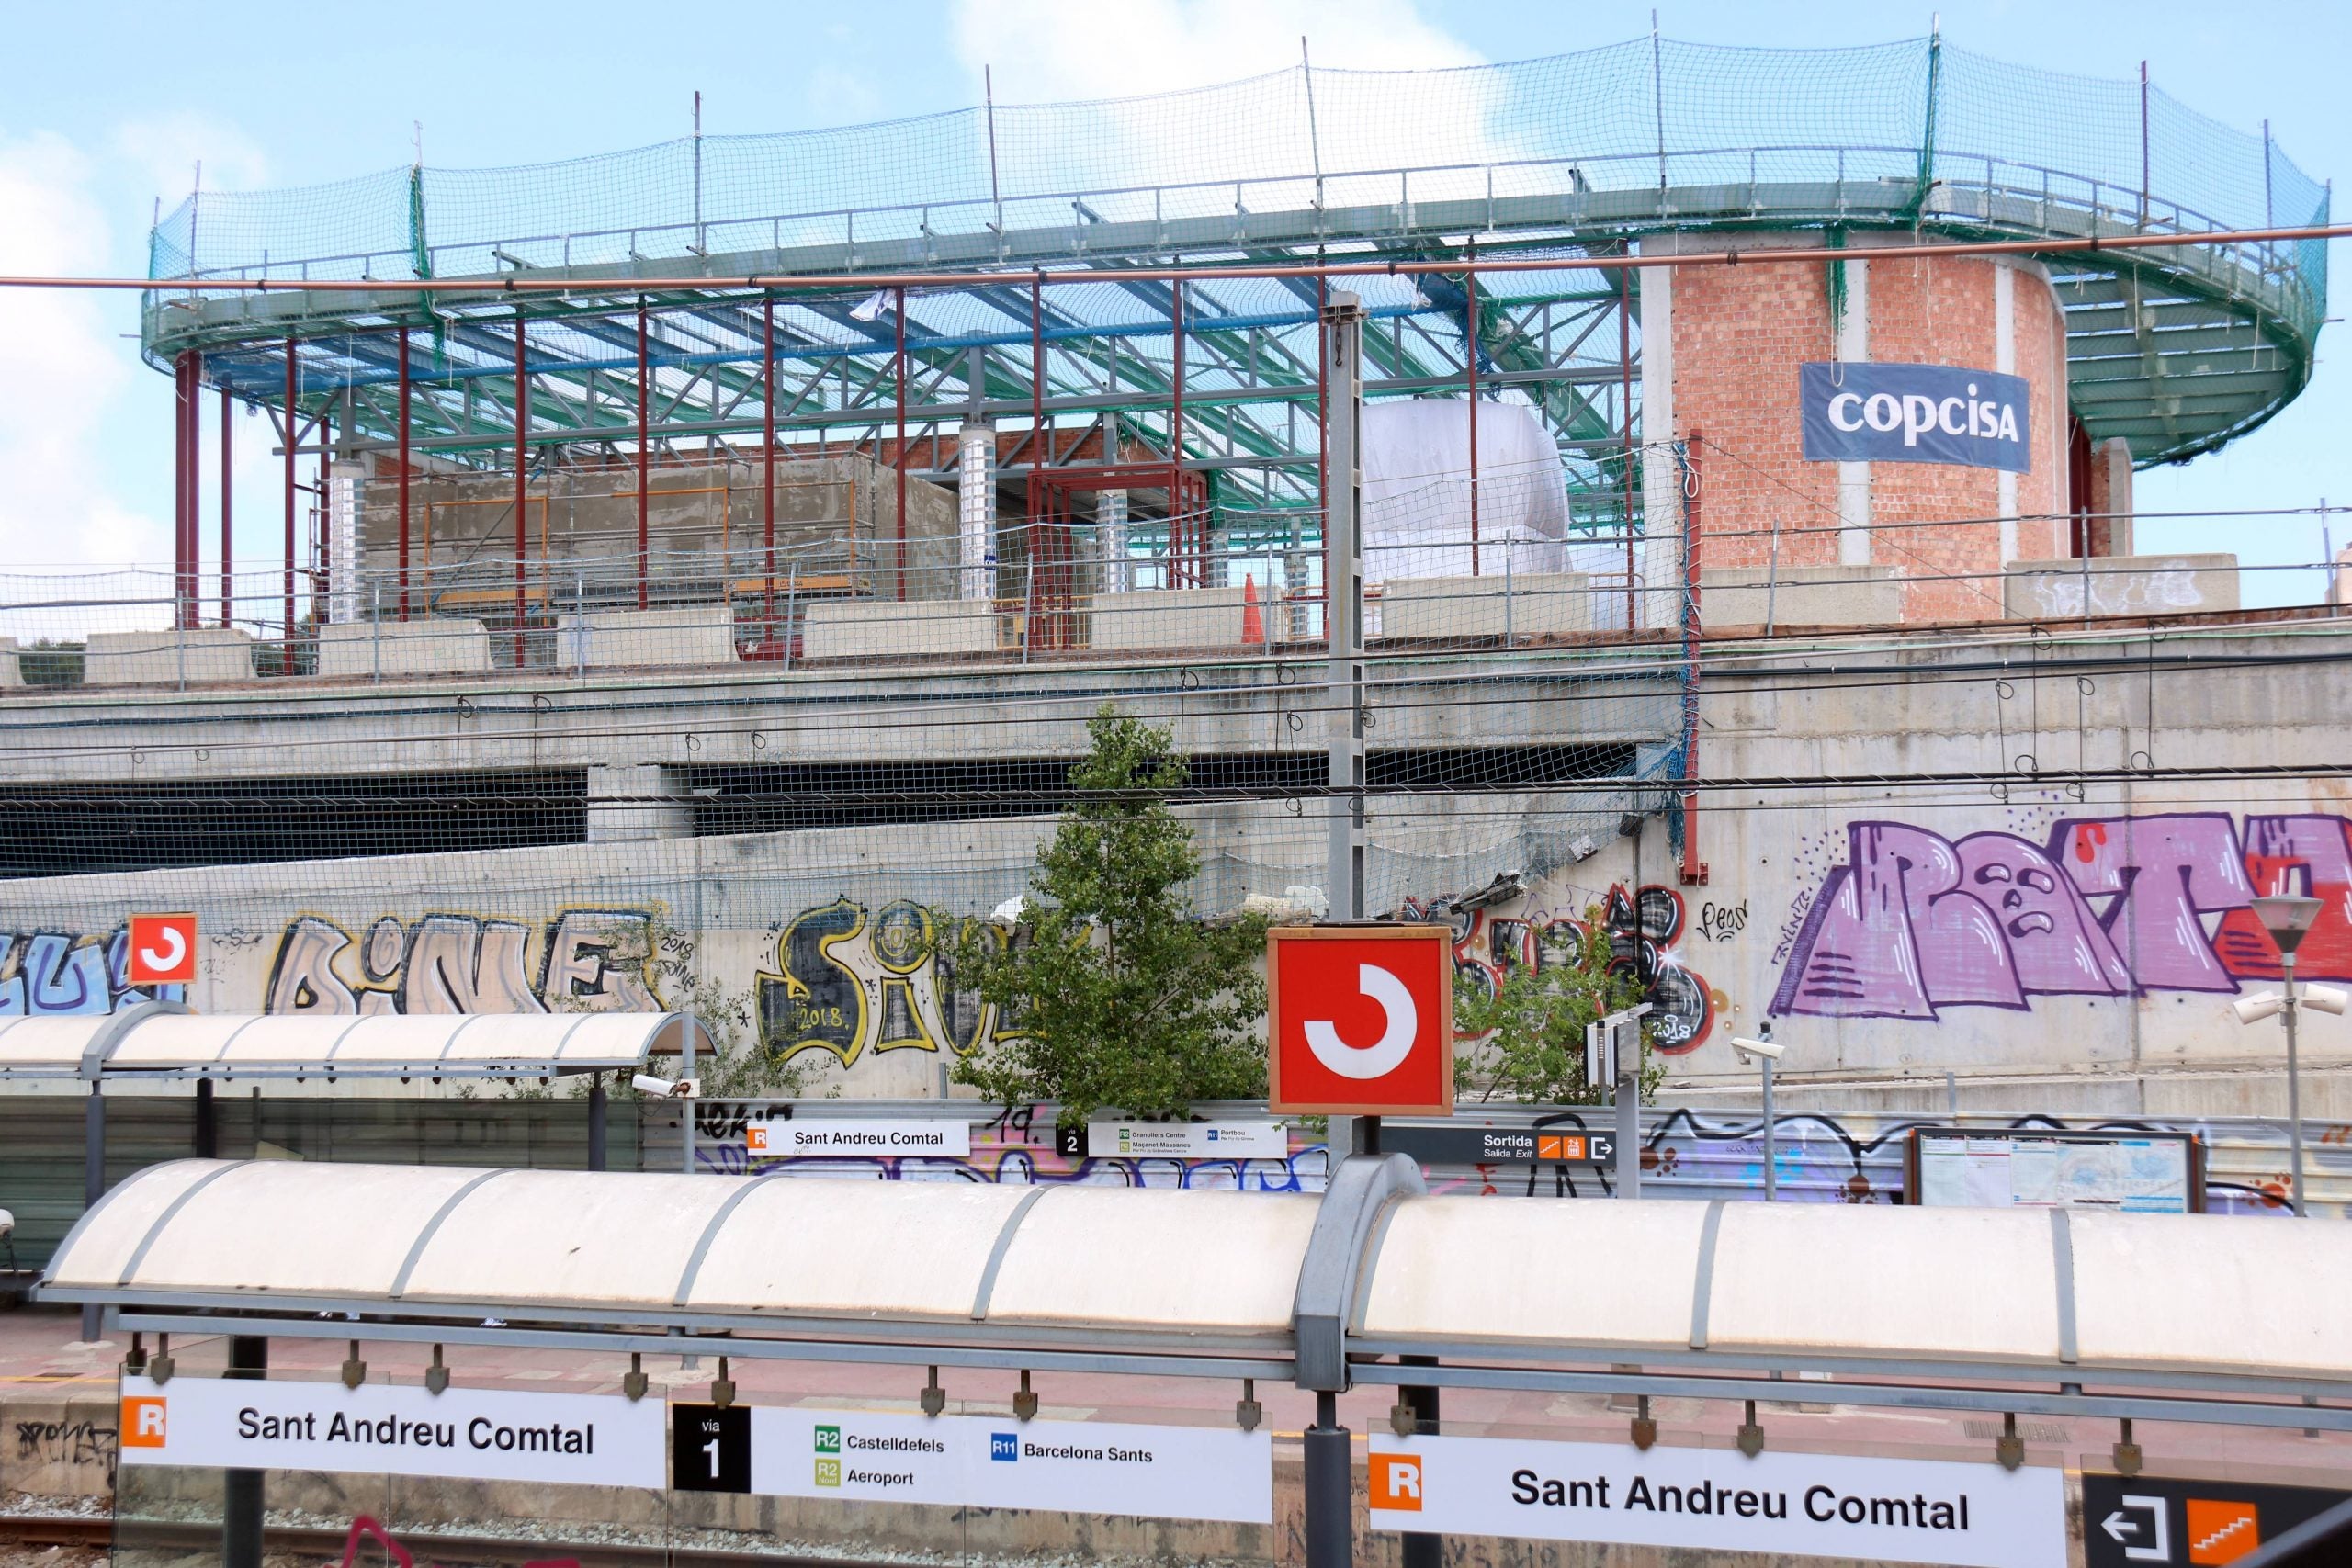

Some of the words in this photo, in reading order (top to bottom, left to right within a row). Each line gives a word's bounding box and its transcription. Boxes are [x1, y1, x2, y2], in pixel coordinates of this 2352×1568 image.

[661, 937, 695, 961] 2018
[753, 1132, 765, 1145] R
[796, 1133, 827, 1145] Sant
[833, 1133, 886, 1145] Andreu
[891, 1132, 943, 1145] Comtal
[1067, 1136, 1078, 1152] 2
[1484, 1134, 1532, 1147] Sortida
[1484, 1148, 1511, 1158] Salida
[1515, 1149, 1532, 1158] Exit
[139, 1404, 165, 1435] R
[238, 1407, 316, 1440] Sant
[326, 1411, 455, 1448] Andreu
[468, 1417, 594, 1455] Comtal
[702, 1418, 720, 1432] via
[816, 1431, 840, 1449] R2
[847, 1435, 944, 1454] Castelldefels
[703, 1439, 719, 1478] 1
[993, 1440, 1016, 1455] R11
[1024, 1443, 1103, 1460] Barcelona
[1108, 1447, 1153, 1463] Sants
[818, 1463, 838, 1476] R2
[819, 1475, 838, 1484] Nord
[847, 1469, 914, 1488] Aeroport
[1389, 1462, 1419, 1498] R
[1511, 1469, 1611, 1509] Sant
[1624, 1476, 1787, 1519] Andreu
[1804, 1485, 1968, 1530] Comtal
